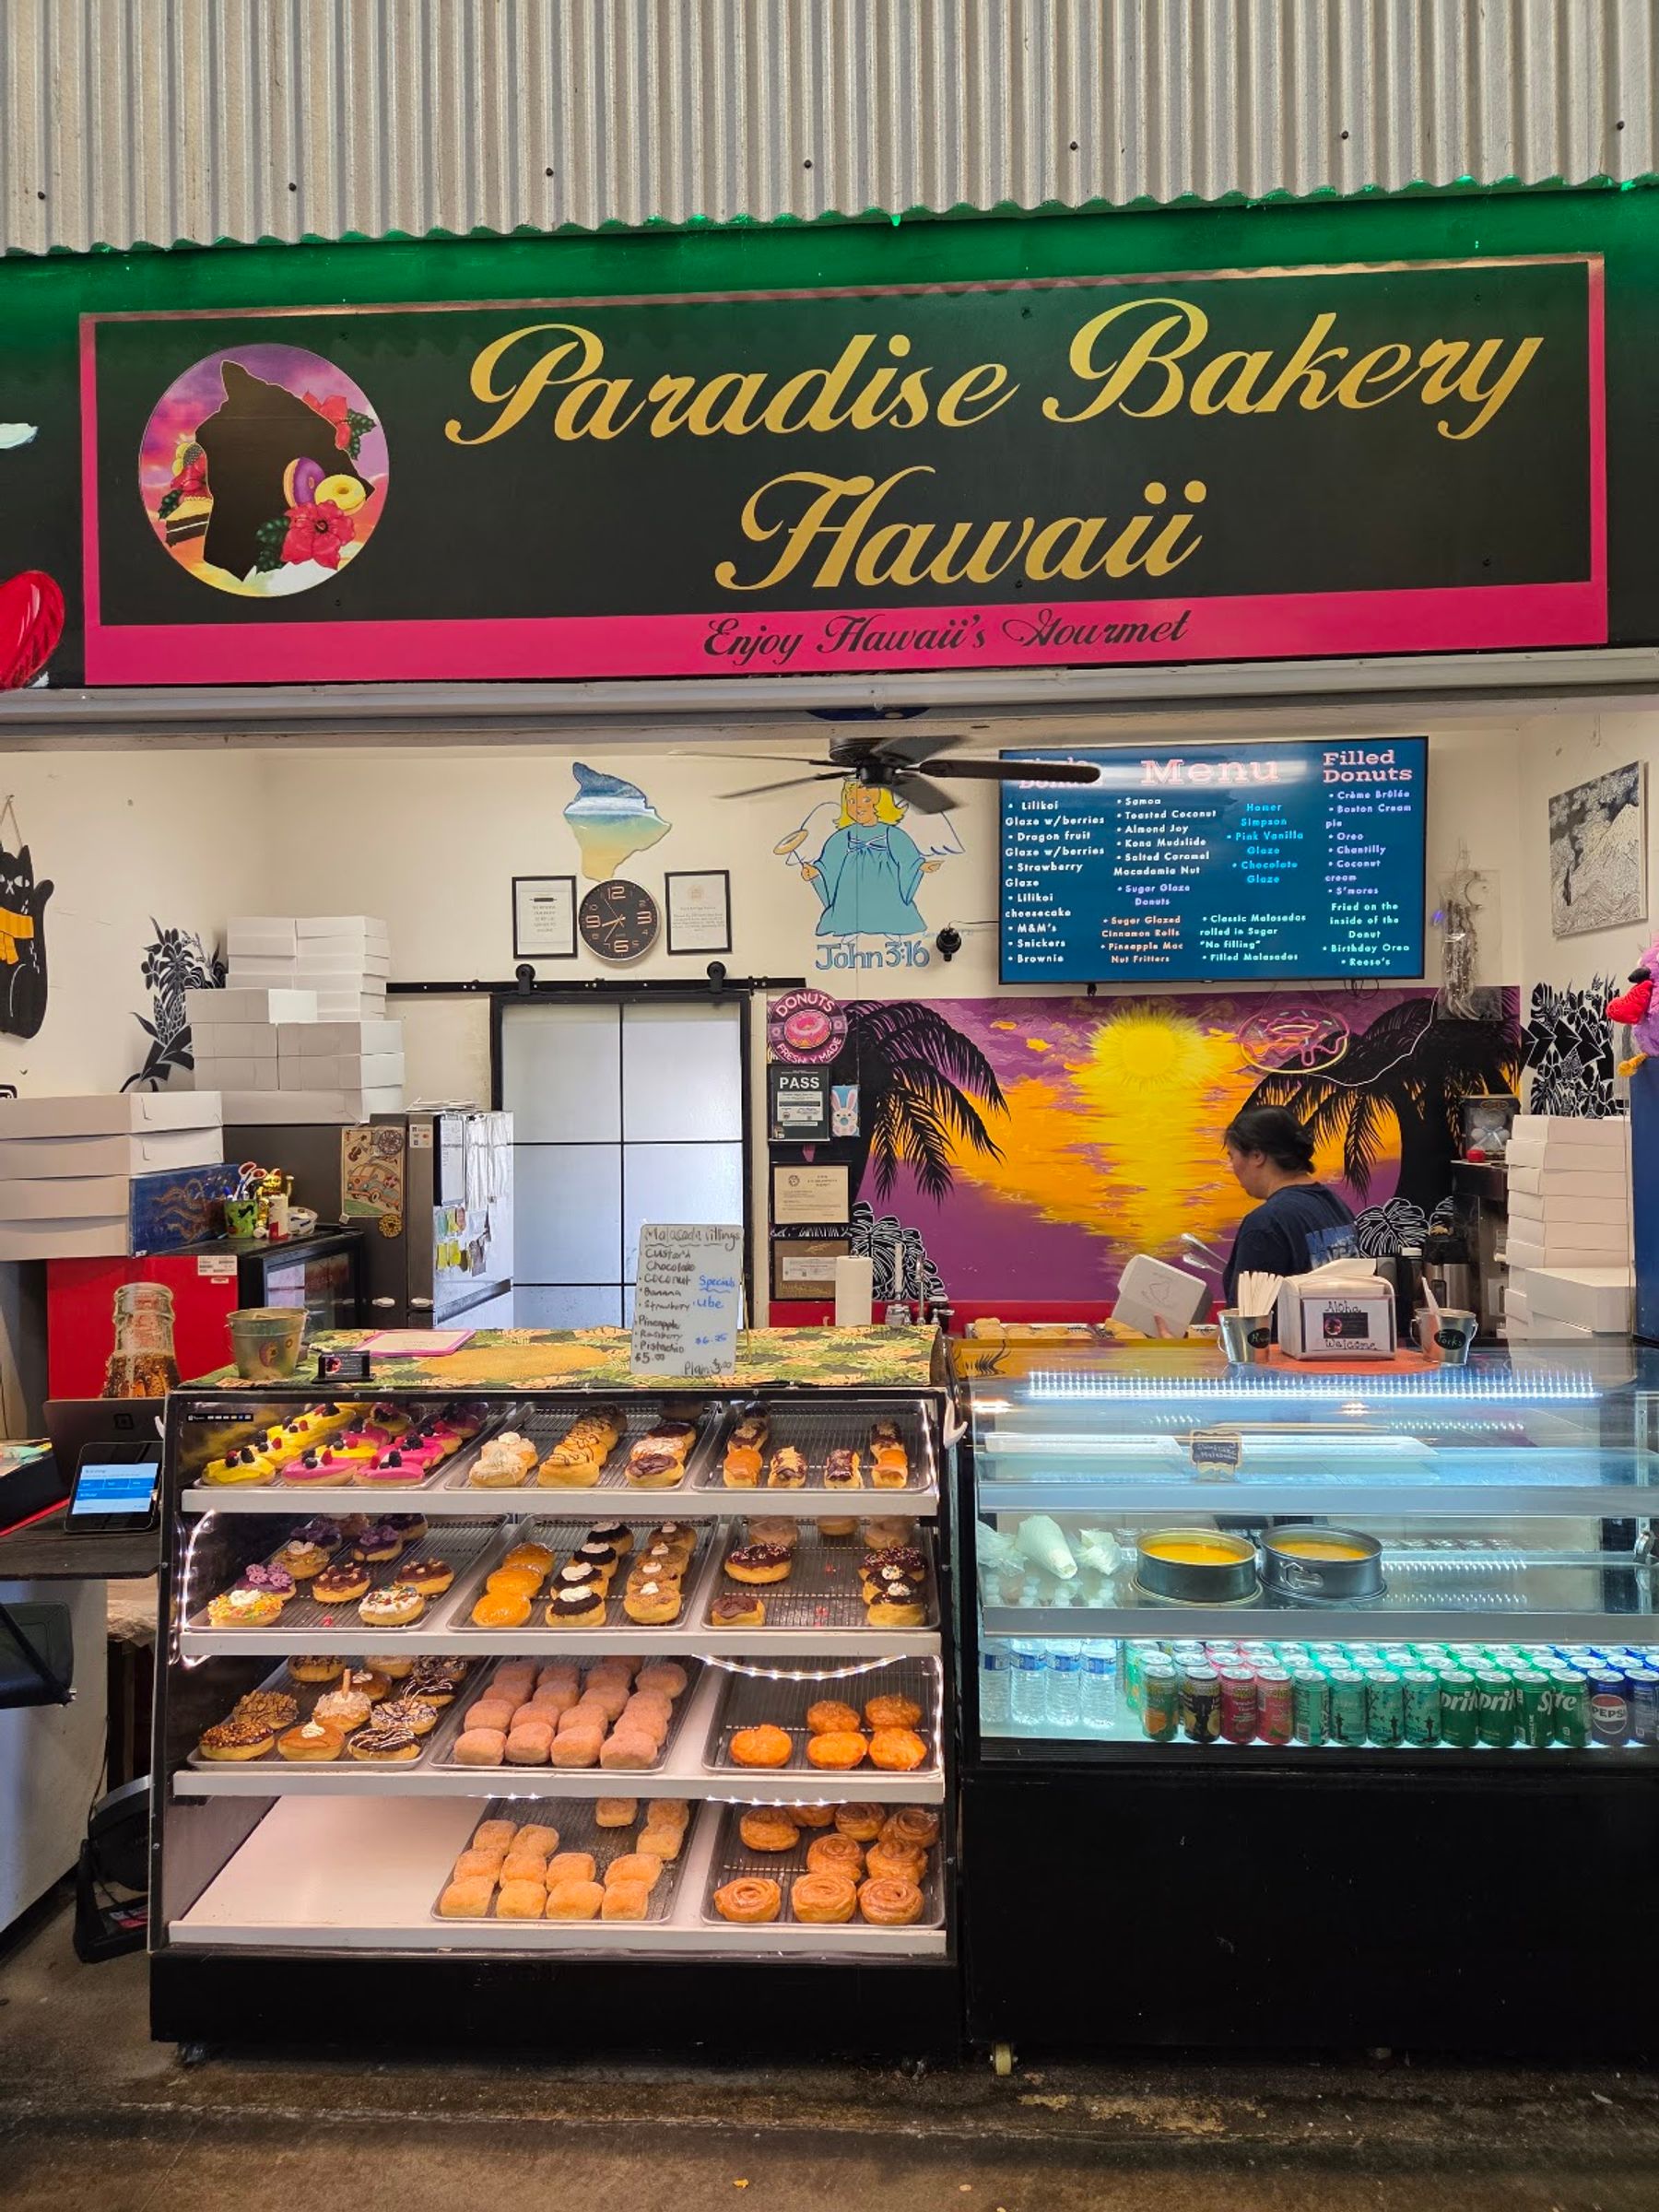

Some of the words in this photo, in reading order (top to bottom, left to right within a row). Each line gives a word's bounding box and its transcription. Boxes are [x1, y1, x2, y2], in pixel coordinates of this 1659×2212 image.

[444, 323, 1020, 445] Paradise
[1041, 296, 1544, 441] Bakery
[713, 464, 1206, 591] Hawaii
[703, 618, 801, 666] Enjoy
[816, 611, 986, 655] Hawaii's
[1001, 608, 1191, 648] Gourmet
[1323, 749, 1395, 767] Filled
[1140, 759, 1281, 785] Menu
[1323, 767, 1413, 783] Donuts
[1124, 796, 1161, 806] Samoa
[1124, 809, 1167, 820] Toasted
[1171, 808, 1218, 819] Coconut
[1246, 803, 1282, 813] Homer
[1336, 804, 1373, 814] Boston
[1377, 803, 1412, 813] Cream
[1006, 817, 1040, 827] Glaze
[1044, 815, 1105, 828] w/berries
[1241, 817, 1288, 829] Simpson
[1325, 818, 1343, 830] pie
[1124, 823, 1166, 834] Almond
[1170, 824, 1189, 835] Joy
[1017, 831, 1060, 843] Dragon
[1065, 830, 1091, 841] fruit
[1235, 831, 1259, 842] Pink
[1263, 830, 1304, 841] Vanilla
[1336, 831, 1364, 841] Oreo
[1124, 838, 1152, 849] Kona
[1157, 837, 1207, 848] Mudslide
[1006, 847, 1040, 857] Glaze
[1044, 845, 1105, 859] w/berries
[1247, 845, 1280, 855] Glaze
[1336, 844, 1387, 856] Chantilly
[1124, 852, 1160, 863] Salted
[1164, 851, 1210, 862] Caramel
[1017, 862, 1084, 874] Strawberry
[1241, 859, 1299, 870] Chocolate
[1336, 859, 1381, 868] Coconut
[1113, 865, 1177, 877] Macadamia
[1181, 865, 1201, 876] Nut
[1006, 878, 1040, 888] Glaze
[1247, 875, 1280, 884] Glaze
[1324, 874, 1358, 883] cream
[606, 886, 626, 900] 12
[1124, 884, 1156, 896] Sugar
[1159, 883, 1191, 893] Glaze
[1335, 886, 1380, 896] S'mores
[1017, 892, 1053, 903] Lilikoi
[1135, 897, 1171, 907] Donuts
[1331, 901, 1359, 912] Fried
[1364, 903, 1377, 912] on
[1381, 901, 1399, 911] the
[636, 911, 653, 925] 3
[1006, 908, 1071, 919] cheesecake
[1210, 912, 1247, 924] Classic
[1329, 915, 1362, 925] inside
[1367, 914, 1380, 925] of
[1382, 914, 1399, 924] the
[585, 914, 601, 929] 9
[1111, 916, 1142, 927] Sugar
[1144, 914, 1181, 925] Glazed
[1017, 923, 1057, 934] M&M's
[1101, 929, 1150, 939] Cinnamon
[1154, 927, 1180, 937] Rolls
[1199, 926, 1230, 936] rolled
[1234, 927, 1244, 936] in
[1248, 926, 1278, 938] Sugar
[1347, 929, 1382, 939] Donut
[613, 939, 629, 953] 6
[1017, 938, 1066, 948] Snickers
[1108, 941, 1159, 953] Pineapple
[1162, 940, 1183, 950] Mac
[1330, 943, 1378, 955] Birthday
[1382, 943, 1411, 953] Oreo
[816, 942, 883, 971] John
[885, 940, 931, 969] 3:16
[1017, 953, 1065, 964] Brownie
[1111, 955, 1131, 965] Nut
[1133, 954, 1171, 964] Fritters
[1210, 951, 1239, 962] Filled
[1348, 957, 1391, 967] Reese's
[775, 992, 836, 1018] DONUTS
[818, 1037, 842, 1062] MADE
[779, 1077, 820, 1089] PASS
[644, 1273, 691, 1286] Coconut
[644, 1287, 682, 1297] Banana
